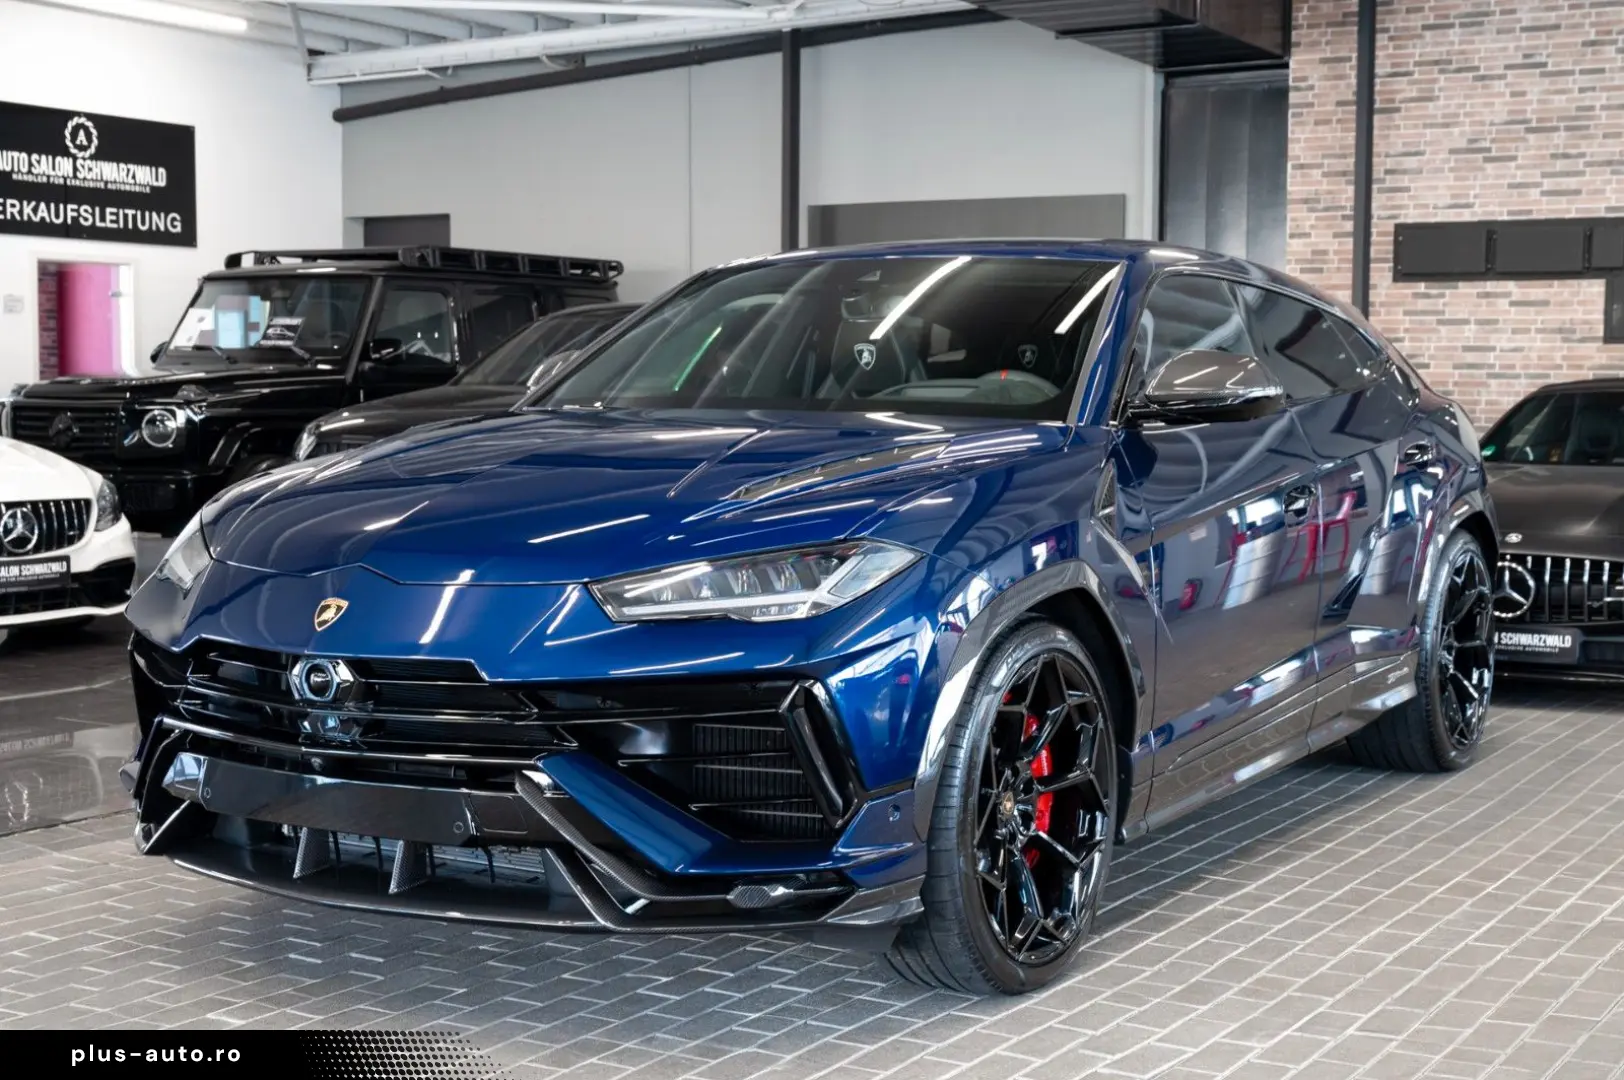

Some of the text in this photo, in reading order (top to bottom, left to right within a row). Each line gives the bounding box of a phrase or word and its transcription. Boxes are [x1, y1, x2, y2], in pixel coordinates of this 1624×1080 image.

[75, 128, 89, 146] A
[31, 153, 73, 177] SALON
[76, 158, 166, 187] SCHWARZWALD
[1500, 632, 1572, 648] SCHWARZWALD
